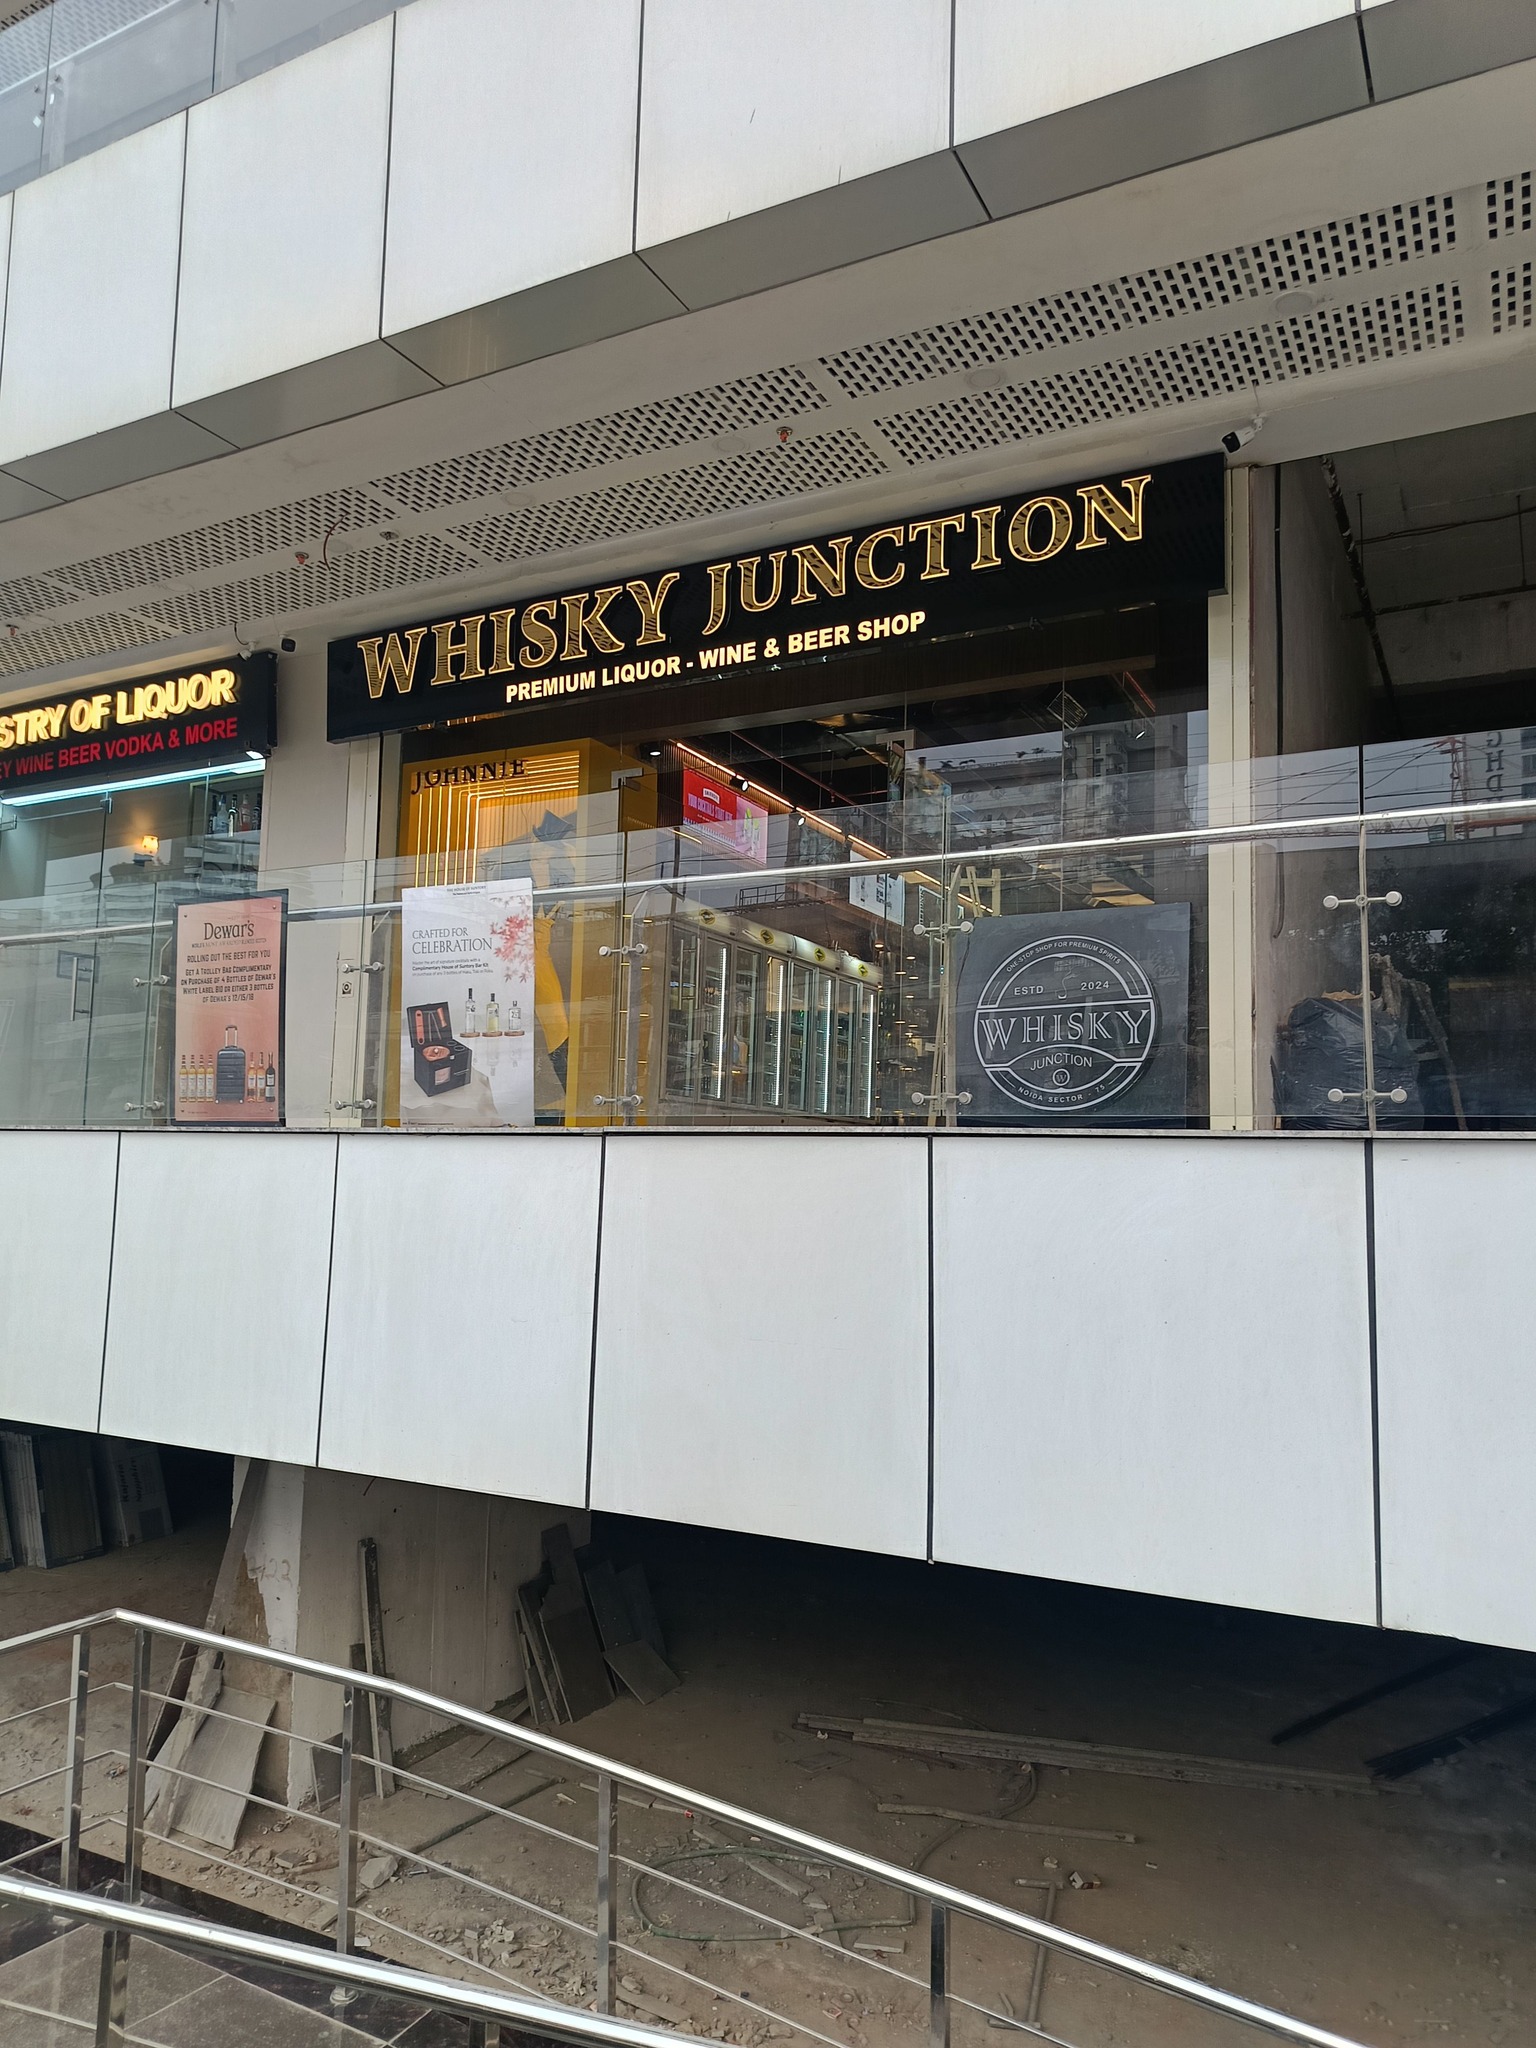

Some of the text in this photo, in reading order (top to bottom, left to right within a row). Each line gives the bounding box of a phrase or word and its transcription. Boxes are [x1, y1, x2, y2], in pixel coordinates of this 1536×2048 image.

[357, 474, 1152, 699] WHISKY JUNCTION
[505, 670, 595, 702] PREMIUM
[602, 658, 680, 687] LIQUOR
[699, 640, 756, 669] WINE
[763, 636, 780, 659] &
[788, 624, 849, 655] BEER
[857, 611, 926, 643] SHOP
[69, 694, 111, 733] OF
[116, 668, 237, 725] LIQUOR
[16, 751, 54, 776] WINE
[58, 743, 101, 768] BEER
[106, 732, 164, 760] VODKA
[168, 728, 180, 748] &
[185, 717, 238, 746] MORE
[411, 759, 529, 795] JOHNNIE
[204, 920, 254, 940] Dewar's
[412, 927, 468, 939] CRAFTED FOR
[412, 938, 492, 954] CELEBRATION
[1069, 941, 1099, 951] PREMIUM
[1098, 948, 1122, 965] SPIRITS
[187, 949, 271, 963] ROLLING OUT THE BEST FOR YOU
[185, 968, 195, 976] GET
[200, 967, 221, 975] TROLLEY
[188, 977, 213, 985] PURCHASE
[226, 975, 247, 983] BOTTLES
[182, 987, 198, 995] WHITE
[231, 984, 249, 992] EITHER
[253, 983, 274, 991] BOTTLES
[1014, 985, 1044, 996] ESTD
[1080, 980, 1110, 991] 2024
[980, 1009, 1150, 1051] WHISKY
[1030, 1052, 1093, 1071] JUNCTION
[1017, 1086, 1043, 1101] NOIDA
[1048, 1094, 1084, 1103] SECTOR
[1095, 1084, 1105, 1093] 75
